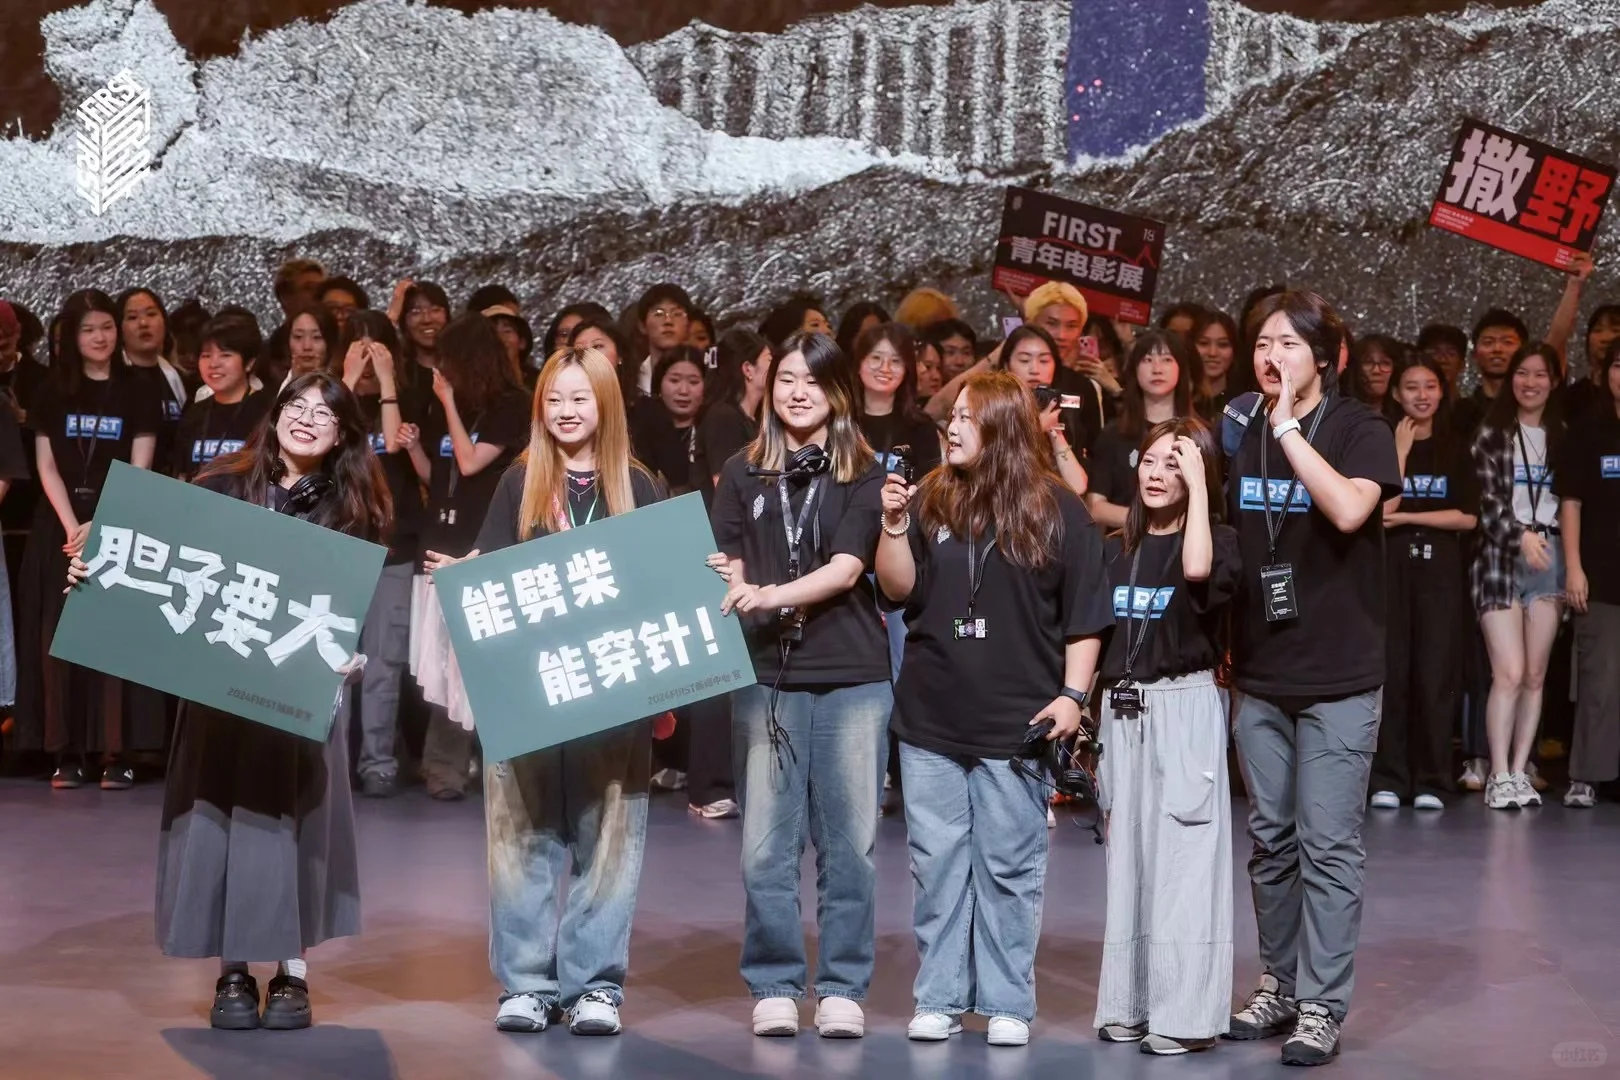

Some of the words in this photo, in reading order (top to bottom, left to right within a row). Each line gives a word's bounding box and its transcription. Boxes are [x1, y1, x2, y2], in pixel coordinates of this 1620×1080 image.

[1445, 128, 1611, 243] 撒野
[1010, 236, 1145, 292] 青年电影展
[1042, 211, 1122, 251] FIRST
[68, 416, 120, 431] FIRST
[1243, 481, 1306, 500] FIRST
[84, 524, 357, 673] 胆子要大
[461, 548, 620, 641] 能劈柴
[538, 606, 719, 706] 能穿针！
